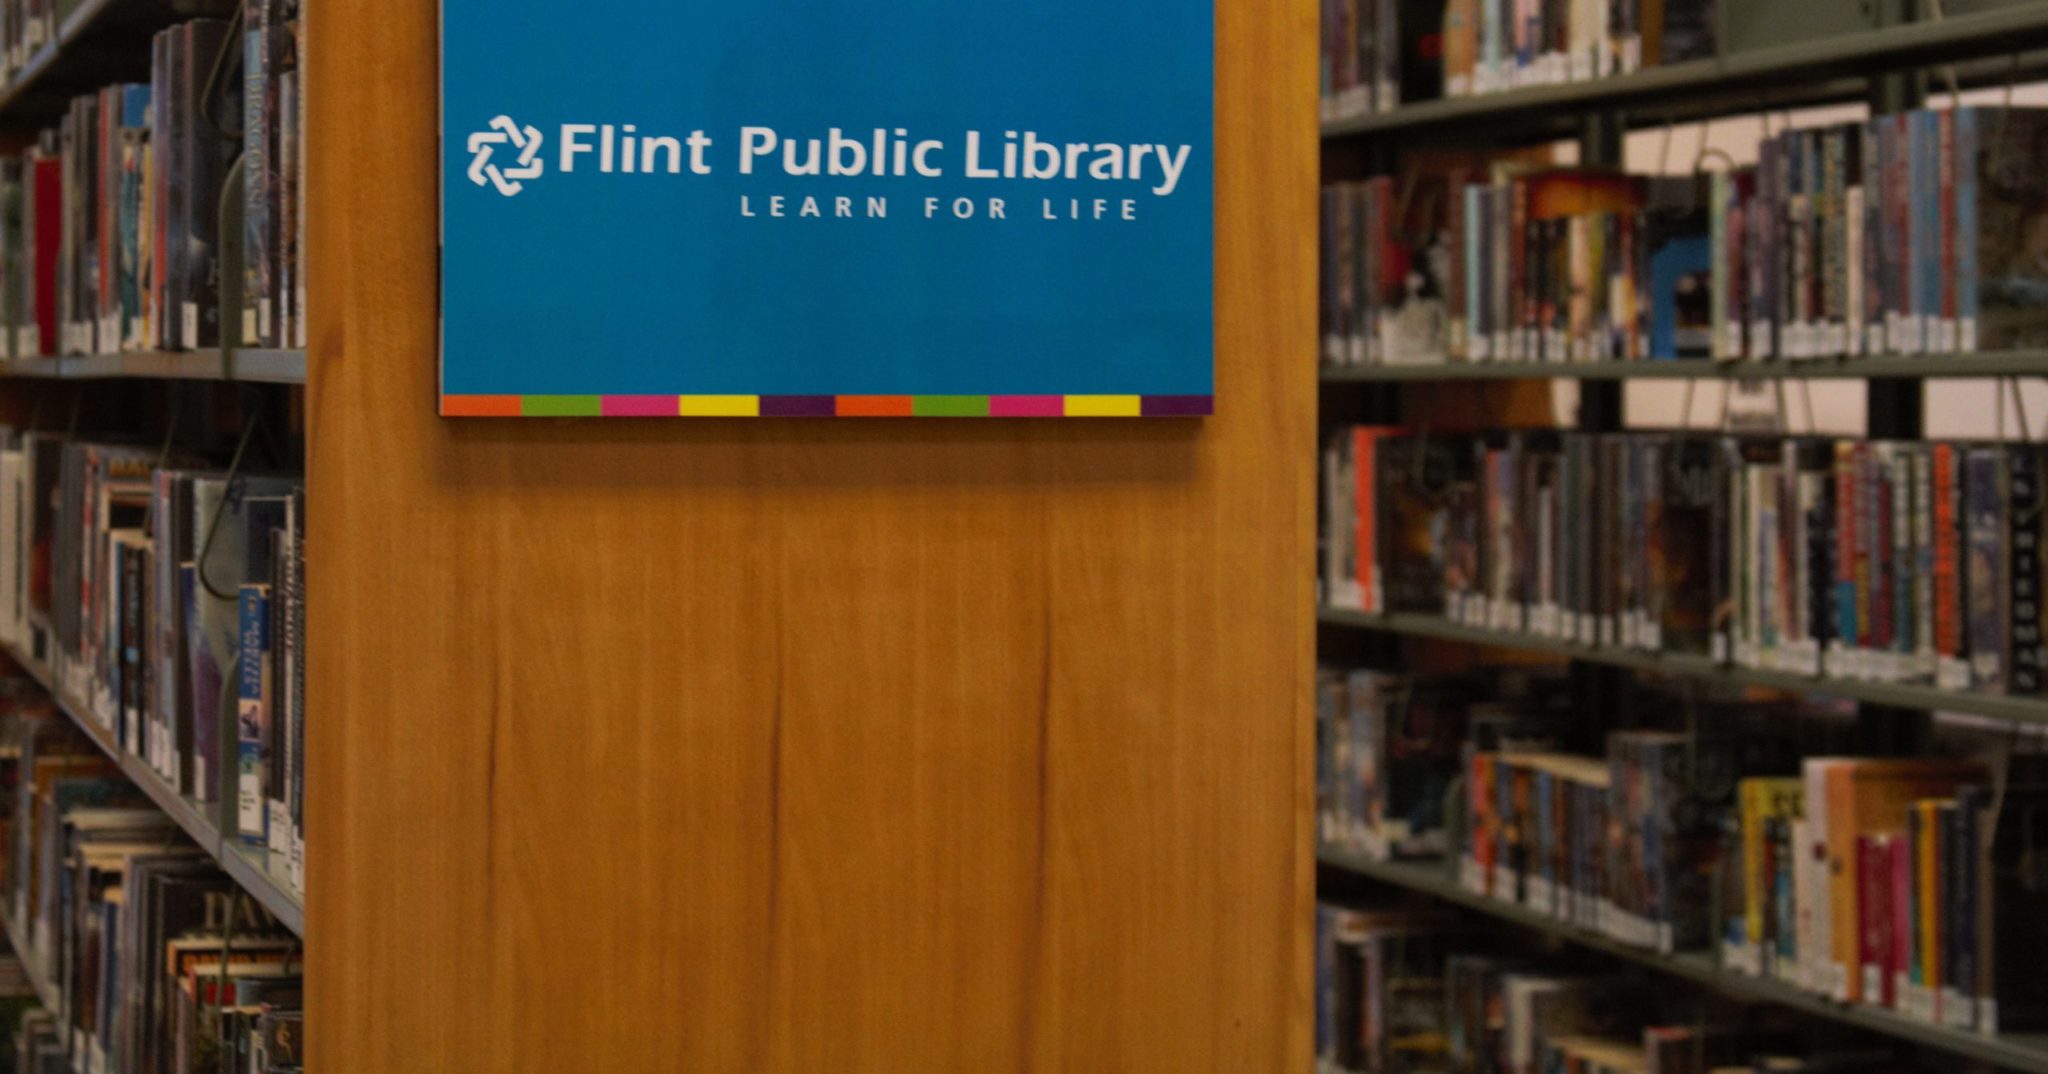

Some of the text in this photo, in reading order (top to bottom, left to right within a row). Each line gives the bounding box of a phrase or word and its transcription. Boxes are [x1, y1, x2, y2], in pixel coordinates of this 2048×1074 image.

[559, 123, 1191, 196] Flint Public Library
[741, 195, 1139, 220] LEARN FOR LIFE
